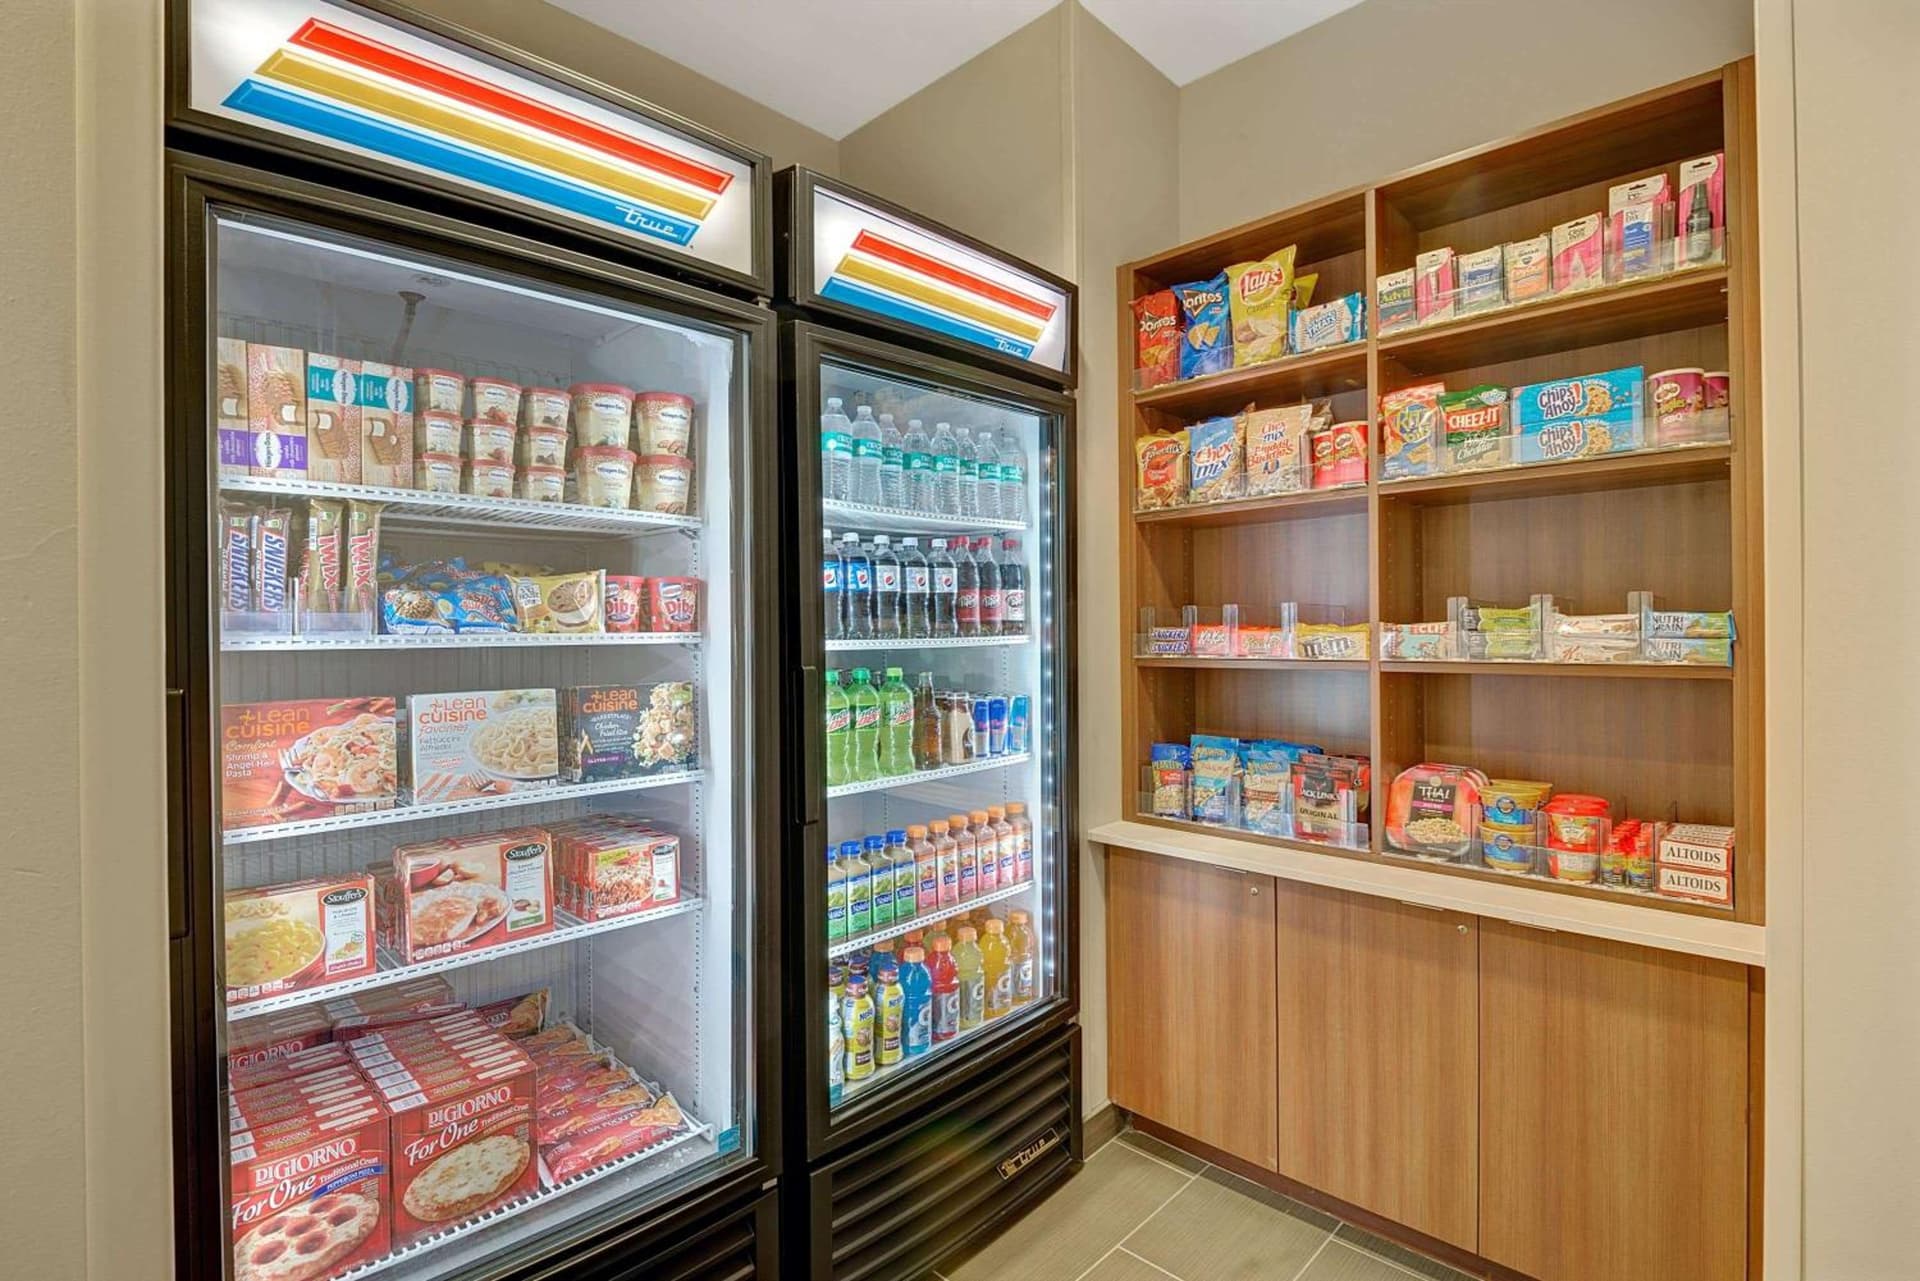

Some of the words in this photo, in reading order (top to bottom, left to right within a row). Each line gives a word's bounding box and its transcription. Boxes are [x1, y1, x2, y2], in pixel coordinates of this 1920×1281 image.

[1243, 268, 1281, 297] Lay's
[1449, 407, 1499, 429] CHEEZ-IT
[231, 531, 249, 612] SNICKERS
[318, 528, 341, 590] TWIX
[351, 528, 377, 588] TWIX
[264, 533, 285, 612] SNICKERS
[226, 752, 261, 763] Shrimp
[227, 761, 255, 772] Angel
[226, 769, 252, 778] Pasta
[1418, 786, 1450, 800] THAI
[507, 844, 547, 860] Stouffer's
[1667, 846, 1721, 864] ALTOIDS
[1667, 873, 1722, 892] ALTOIDS
[325, 889, 367, 905] Stouffer's
[229, 1041, 303, 1070] IGIORNO
[428, 1086, 511, 1129] DIGIORNO
[404, 1139, 434, 1167] For
[440, 1116, 479, 1150] One
[255, 1137, 356, 1187] DIGIORNO
[320, 1160, 359, 1184] Traditional
[360, 1156, 379, 1168] Crust
[327, 1171, 355, 1191] PEPPERONI
[356, 1167, 375, 1180] PIZZA
[232, 1197, 263, 1229] For
[270, 1174, 316, 1208] One
